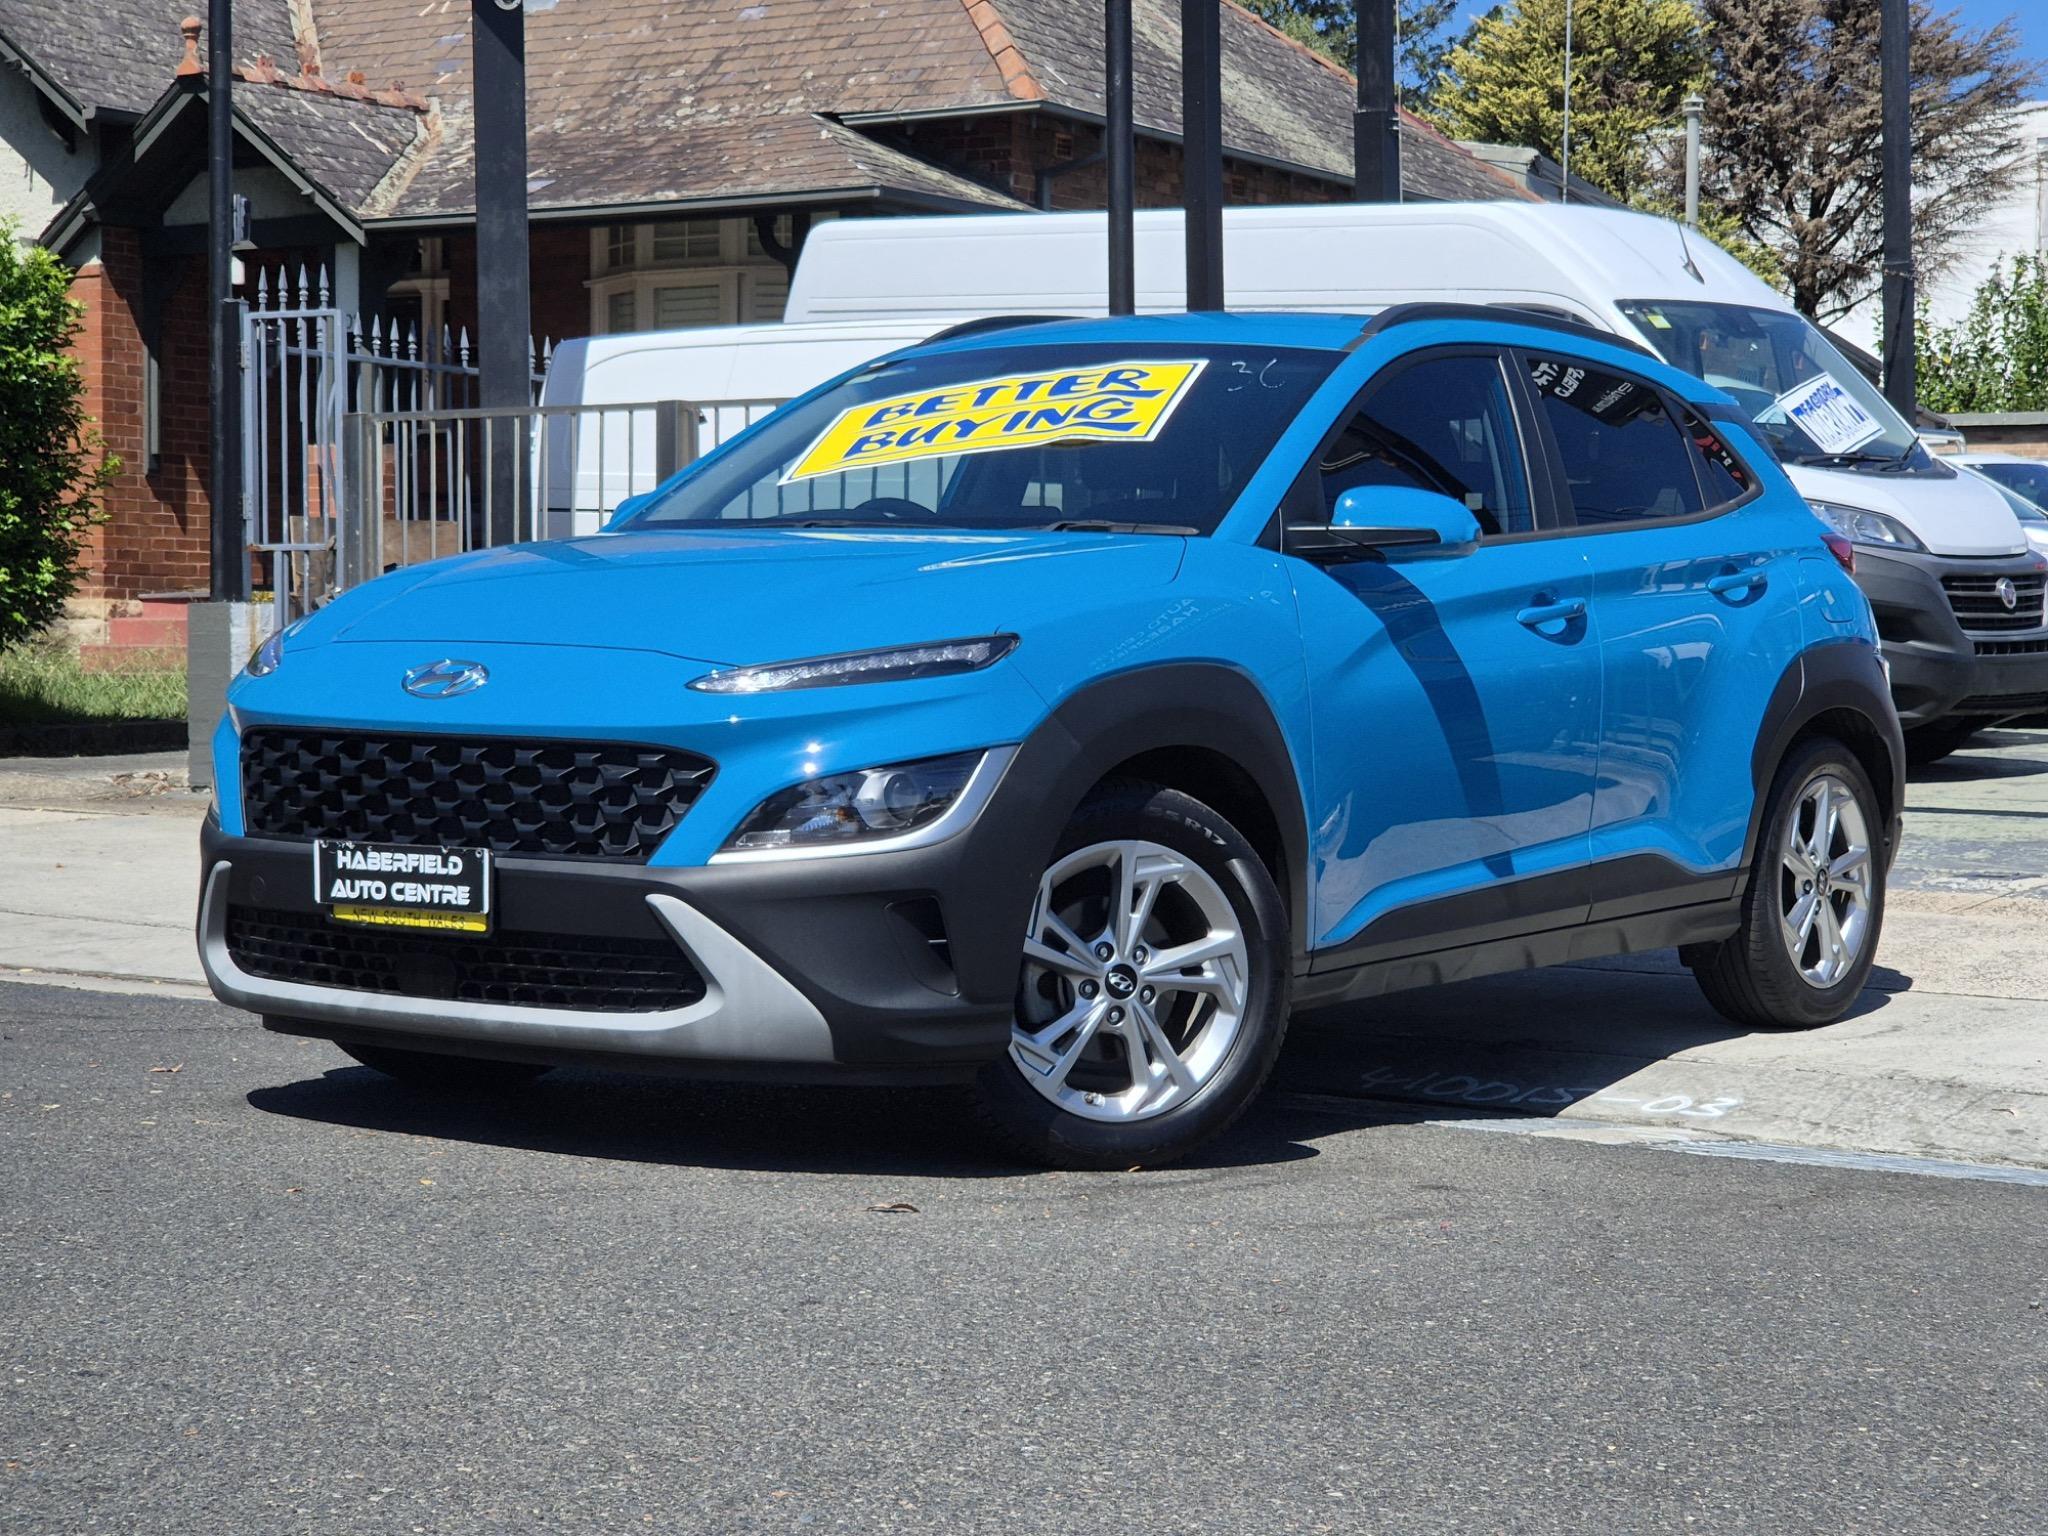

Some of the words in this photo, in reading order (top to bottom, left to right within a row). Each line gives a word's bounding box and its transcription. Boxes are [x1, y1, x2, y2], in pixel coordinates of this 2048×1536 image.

[862, 368, 1152, 430] BETTER
[842, 397, 1136, 460] BUYING
[337, 850, 463, 876] HABERFIELD
[330, 878, 387, 900] AUTO
[391, 881, 471, 906] CENTRE
